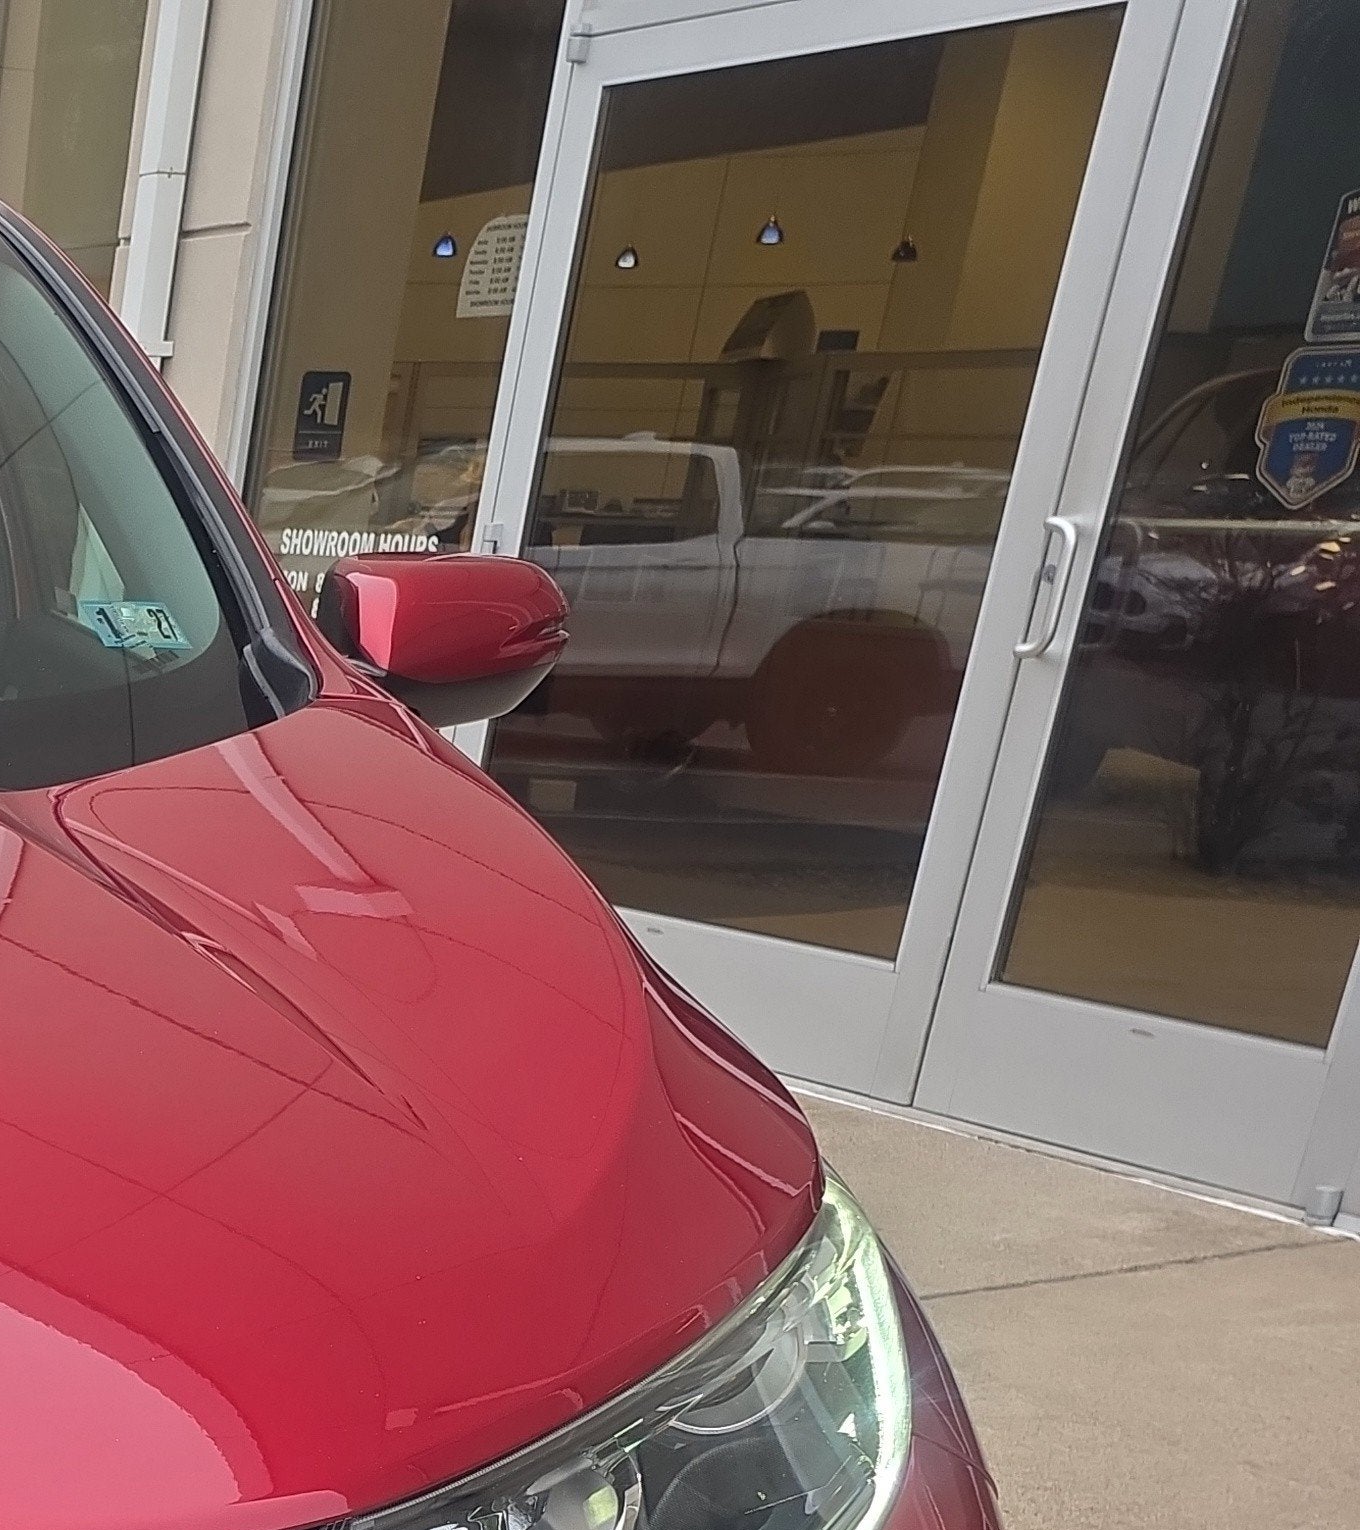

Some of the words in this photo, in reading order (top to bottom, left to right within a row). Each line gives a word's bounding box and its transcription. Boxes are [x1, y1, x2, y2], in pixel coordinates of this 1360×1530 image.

[308, 440, 329, 449] EXIT
[280, 528, 375, 557] SHOWROOM
[378, 533, 440, 552] HOURS
[147, 608, 179, 641] 27
